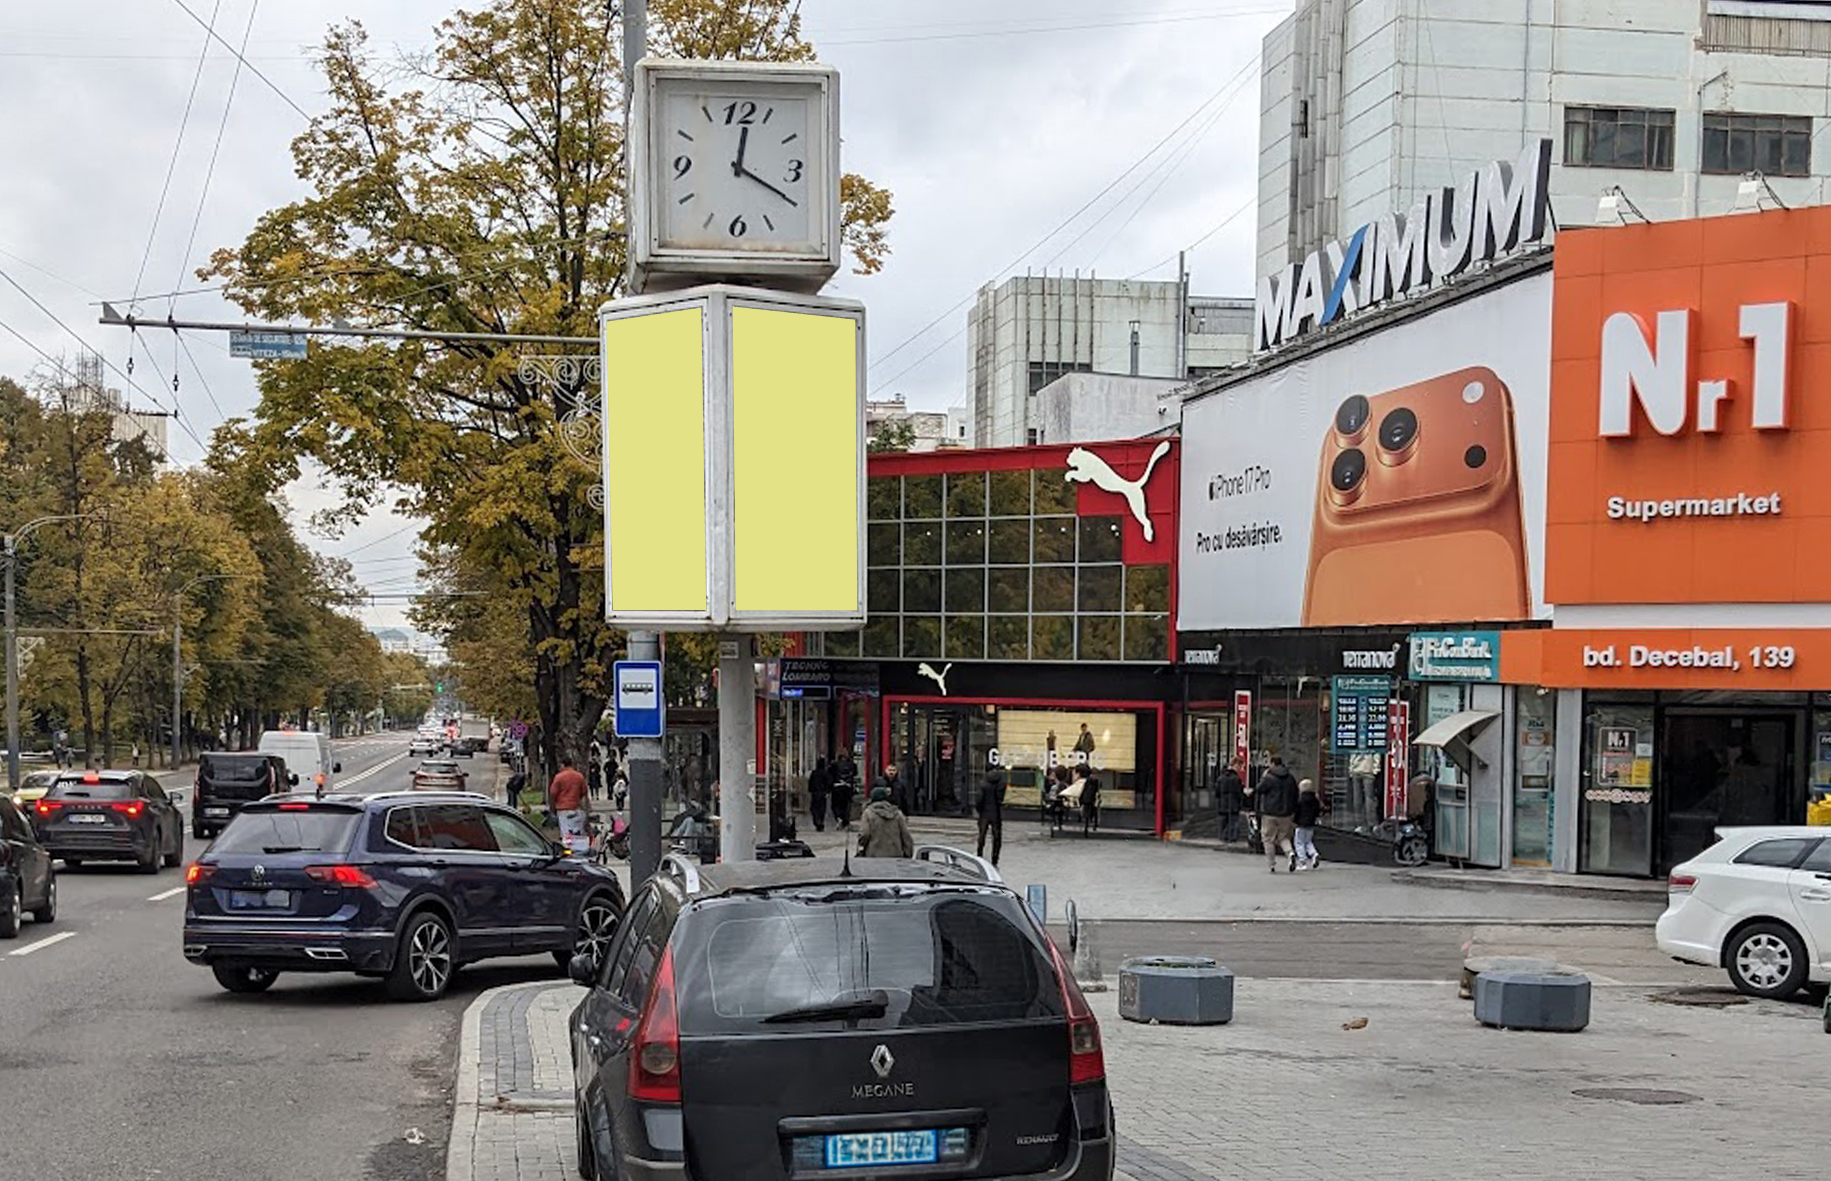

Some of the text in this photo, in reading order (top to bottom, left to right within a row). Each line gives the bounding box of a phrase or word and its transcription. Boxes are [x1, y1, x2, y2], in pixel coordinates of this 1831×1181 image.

[723, 101, 757, 125] 12
[673, 155, 692, 180] 9
[783, 159, 803, 183] 3
[729, 214, 747, 238] 6
[1255, 139, 1554, 350] MAXIMUM
[1214, 465, 1272, 499] iPhone 17 Pro
[1607, 493, 1781, 522] Supermarket
[1196, 532, 1211, 554] Pro
[1212, 534, 1223, 552] cu
[1583, 645, 1796, 672] bd. Decebal, 139
[851, 1082, 915, 1099] MEGANE
